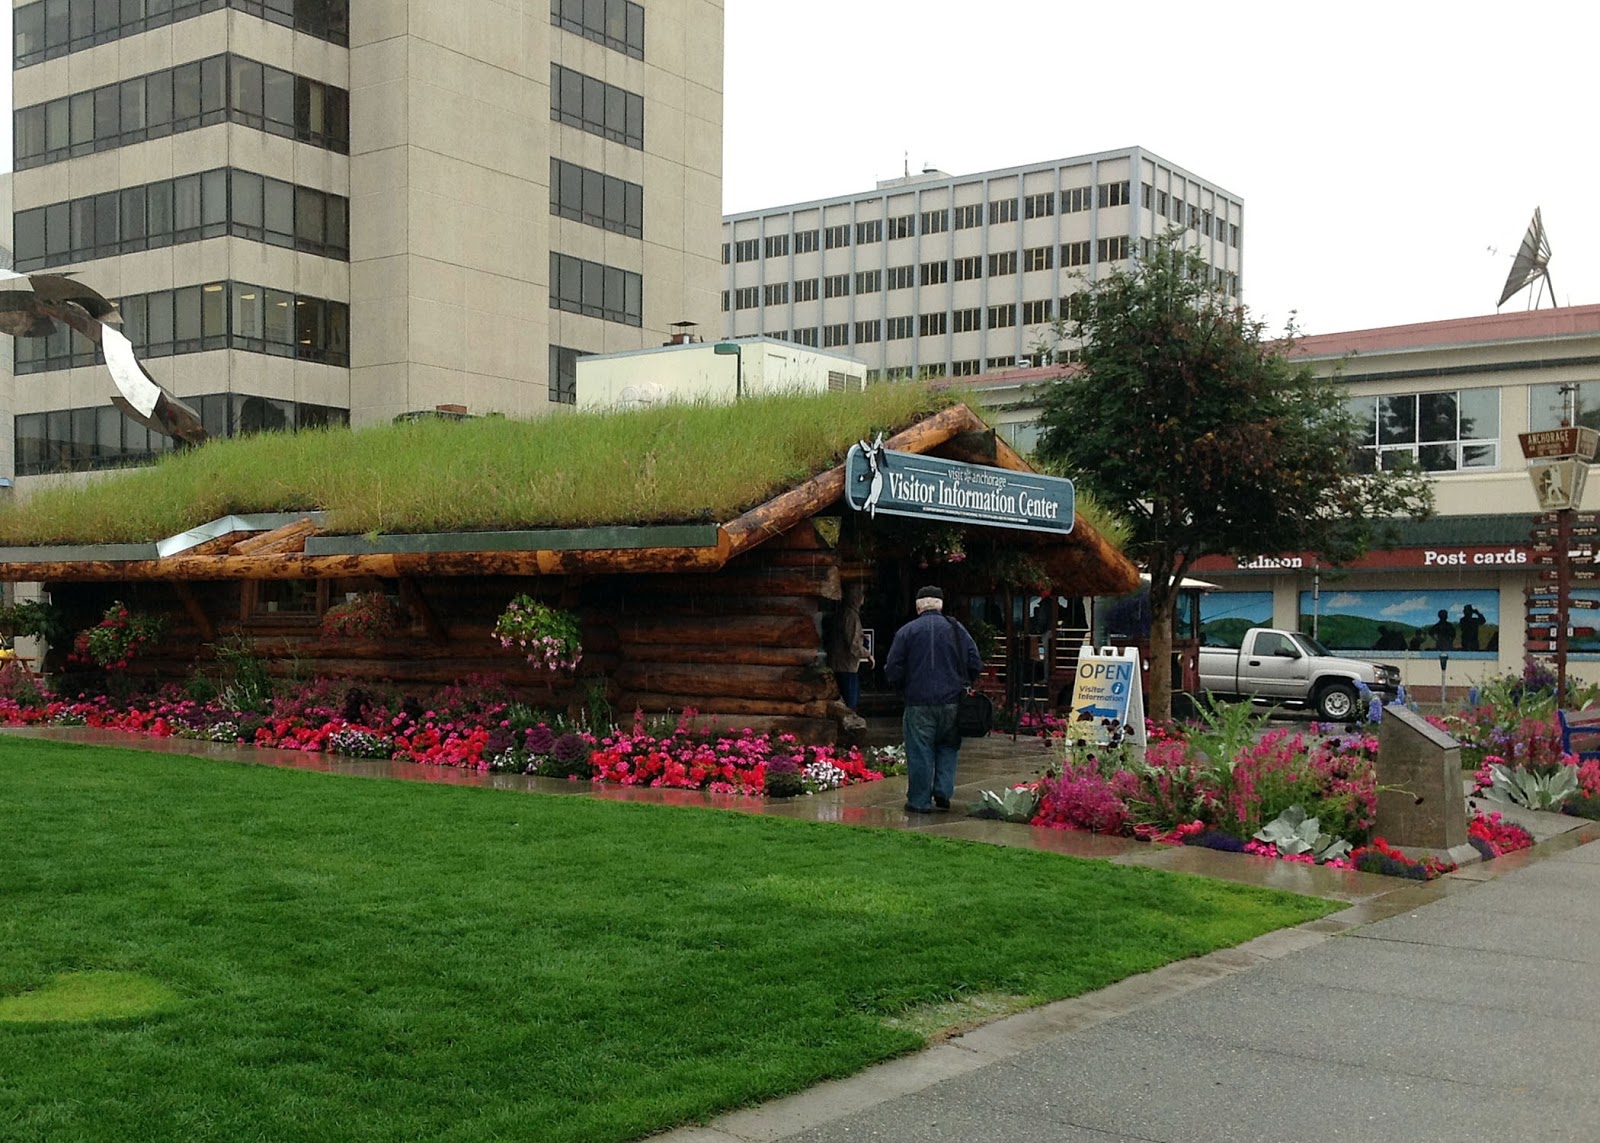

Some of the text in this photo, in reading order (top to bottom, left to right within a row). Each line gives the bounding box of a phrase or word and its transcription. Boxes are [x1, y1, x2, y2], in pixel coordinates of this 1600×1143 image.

[1527, 430, 1570, 445] ANCHORAGE
[947, 467, 1007, 490] visit anchorage
[889, 472, 935, 503] Visitor
[938, 480, 1016, 514] Information
[1018, 491, 1059, 519] Center
[1424, 551, 1467, 565] Post
[1473, 549, 1527, 565] cards
[1080, 663, 1130, 680] OPEN
[1079, 685, 1105, 693] Visitor
[1078, 693, 1124, 702] Information
